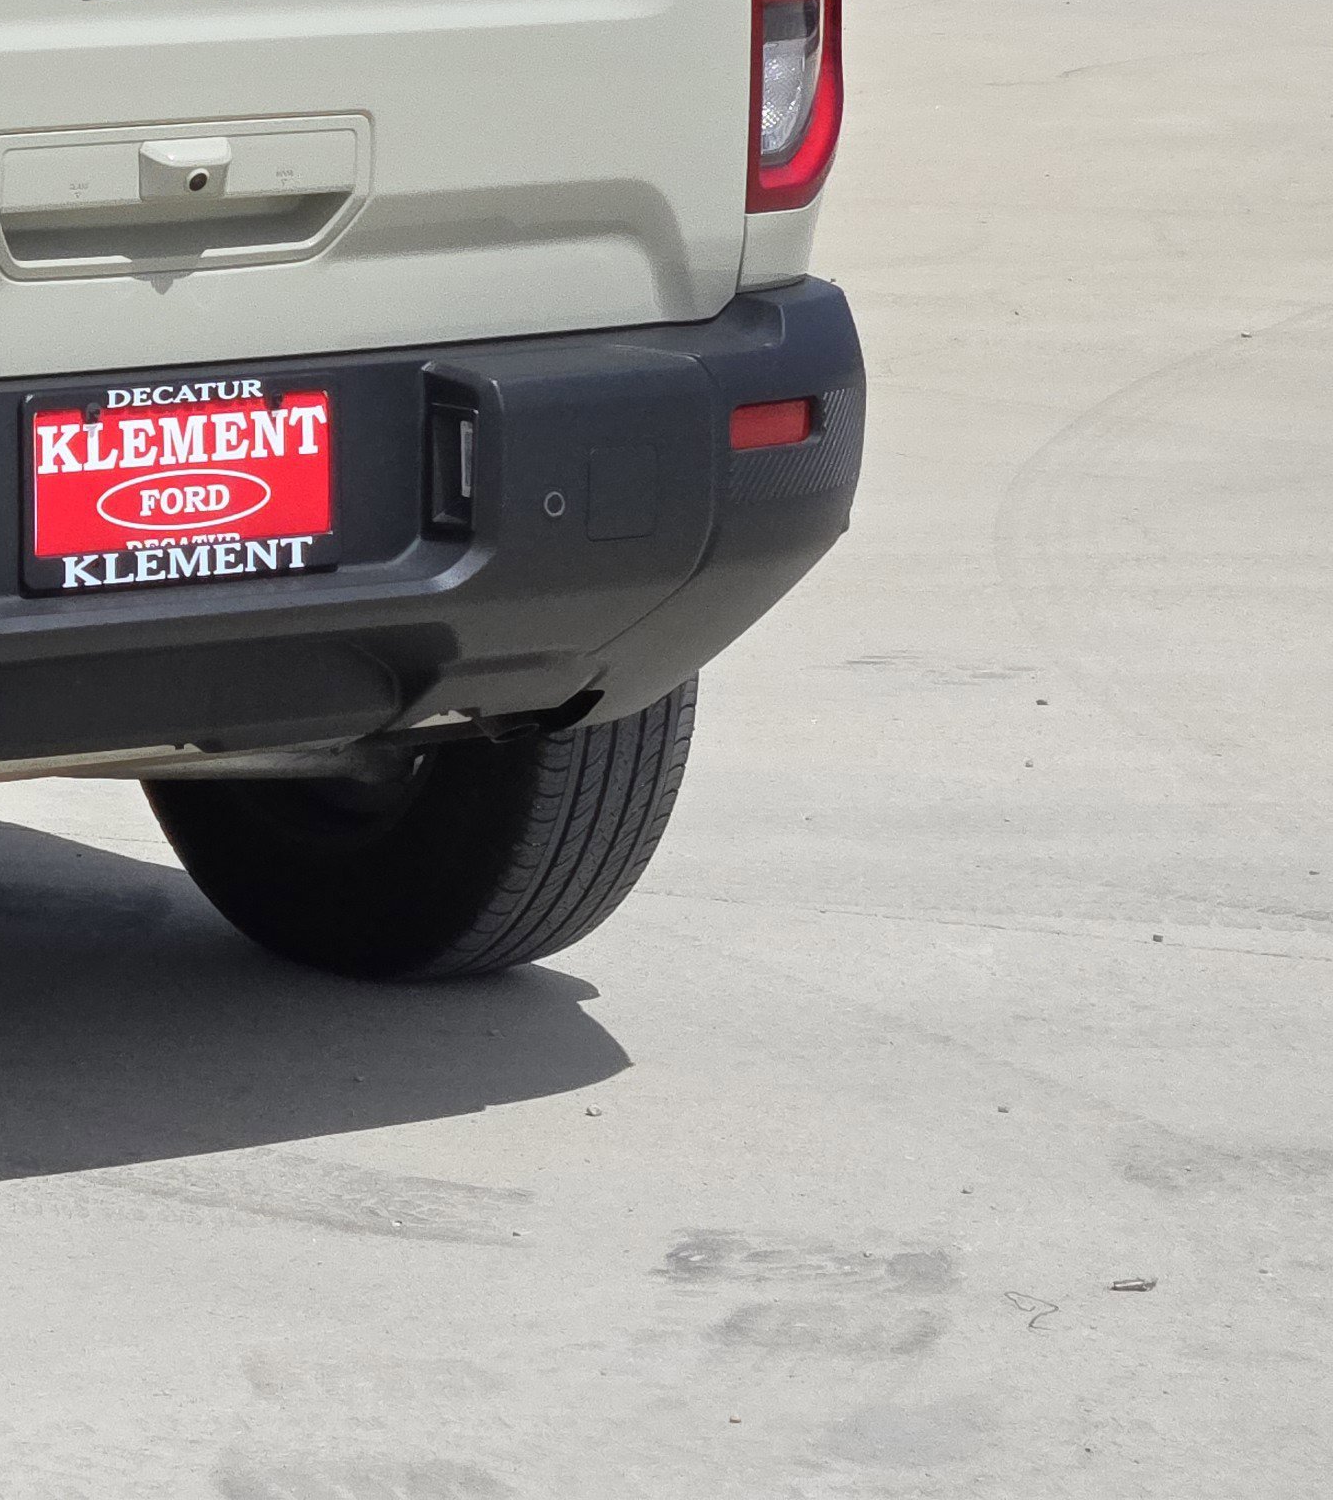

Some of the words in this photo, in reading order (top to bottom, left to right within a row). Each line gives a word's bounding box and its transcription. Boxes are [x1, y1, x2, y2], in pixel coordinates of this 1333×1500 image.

[106, 379, 264, 409] DECATUR
[36, 405, 328, 475] KLEMENT
[139, 483, 231, 517] FORD
[61, 536, 314, 589] KLEMENT
